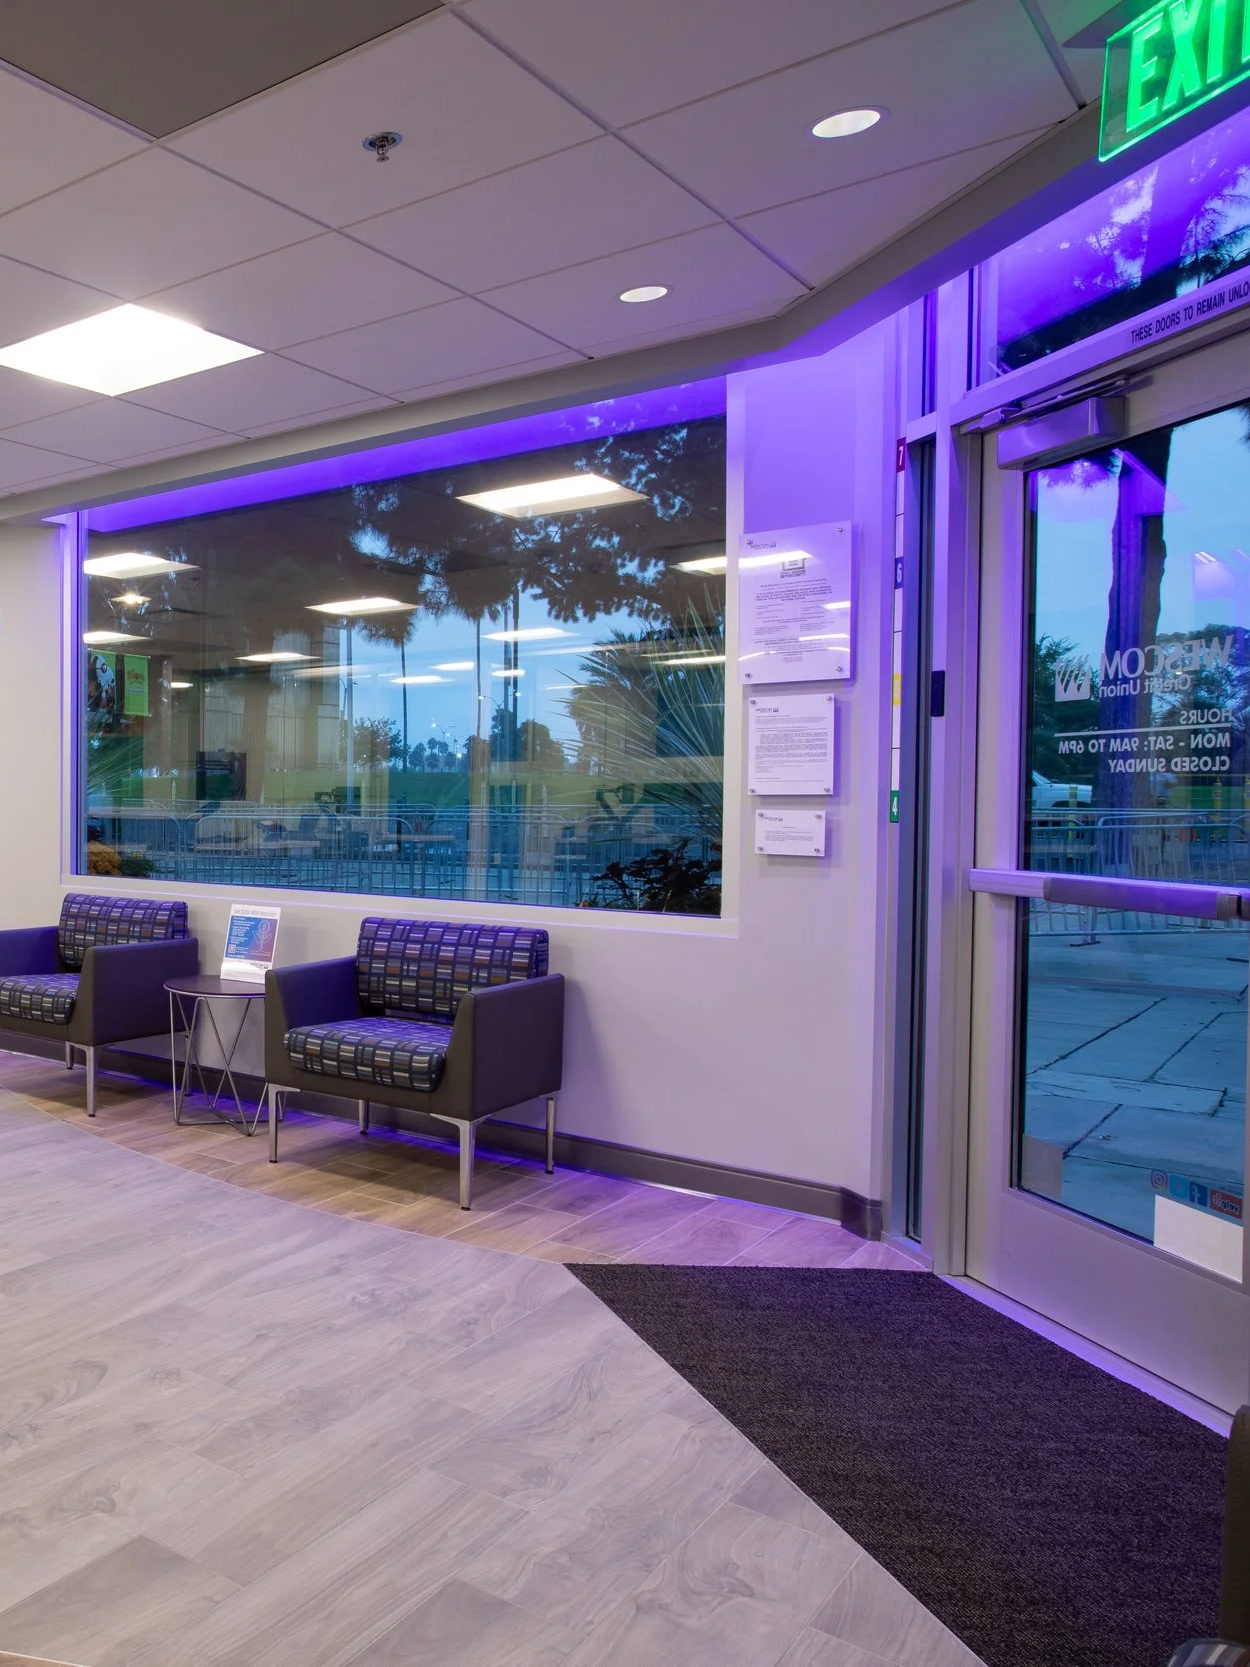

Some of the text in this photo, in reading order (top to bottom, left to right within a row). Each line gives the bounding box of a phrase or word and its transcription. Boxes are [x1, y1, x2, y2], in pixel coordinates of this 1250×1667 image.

[1125, 0, 1250, 133] EXI
[1131, 280, 1250, 344] THESE DOORS TO REMAIN UNLO
[892, 796, 898, 815] 4
